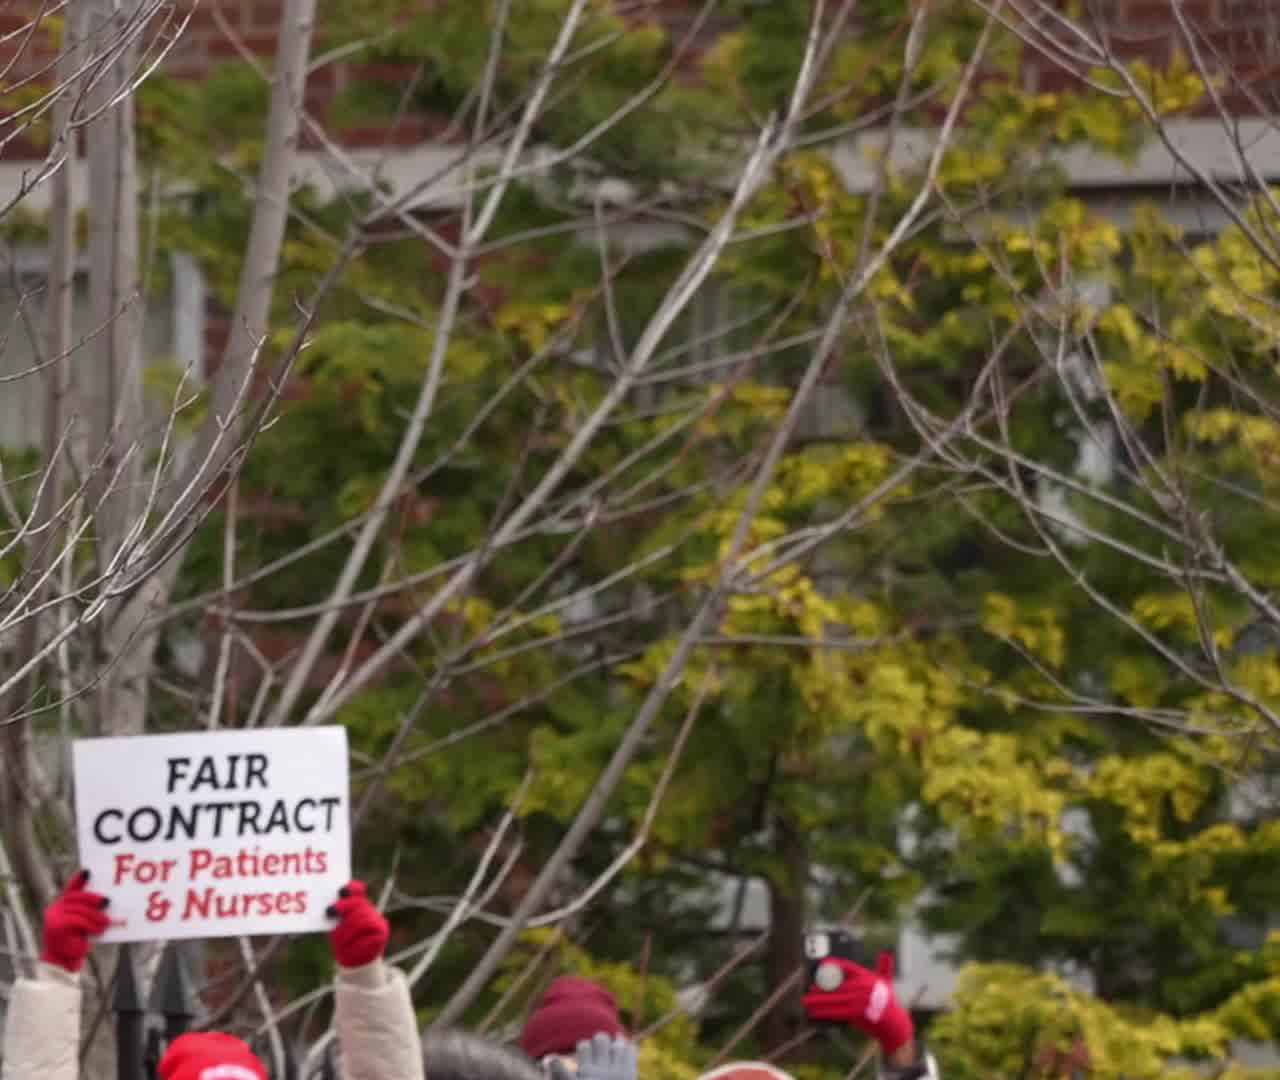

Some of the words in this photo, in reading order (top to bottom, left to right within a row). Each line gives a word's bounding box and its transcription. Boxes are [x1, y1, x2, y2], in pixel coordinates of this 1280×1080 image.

[166, 752, 270, 794] FAIR
[92, 797, 340, 845] CONTRACT
[113, 852, 177, 886] For
[188, 845, 328, 881] Patients
[144, 890, 172, 923] &
[181, 886, 308, 921] Nurses
